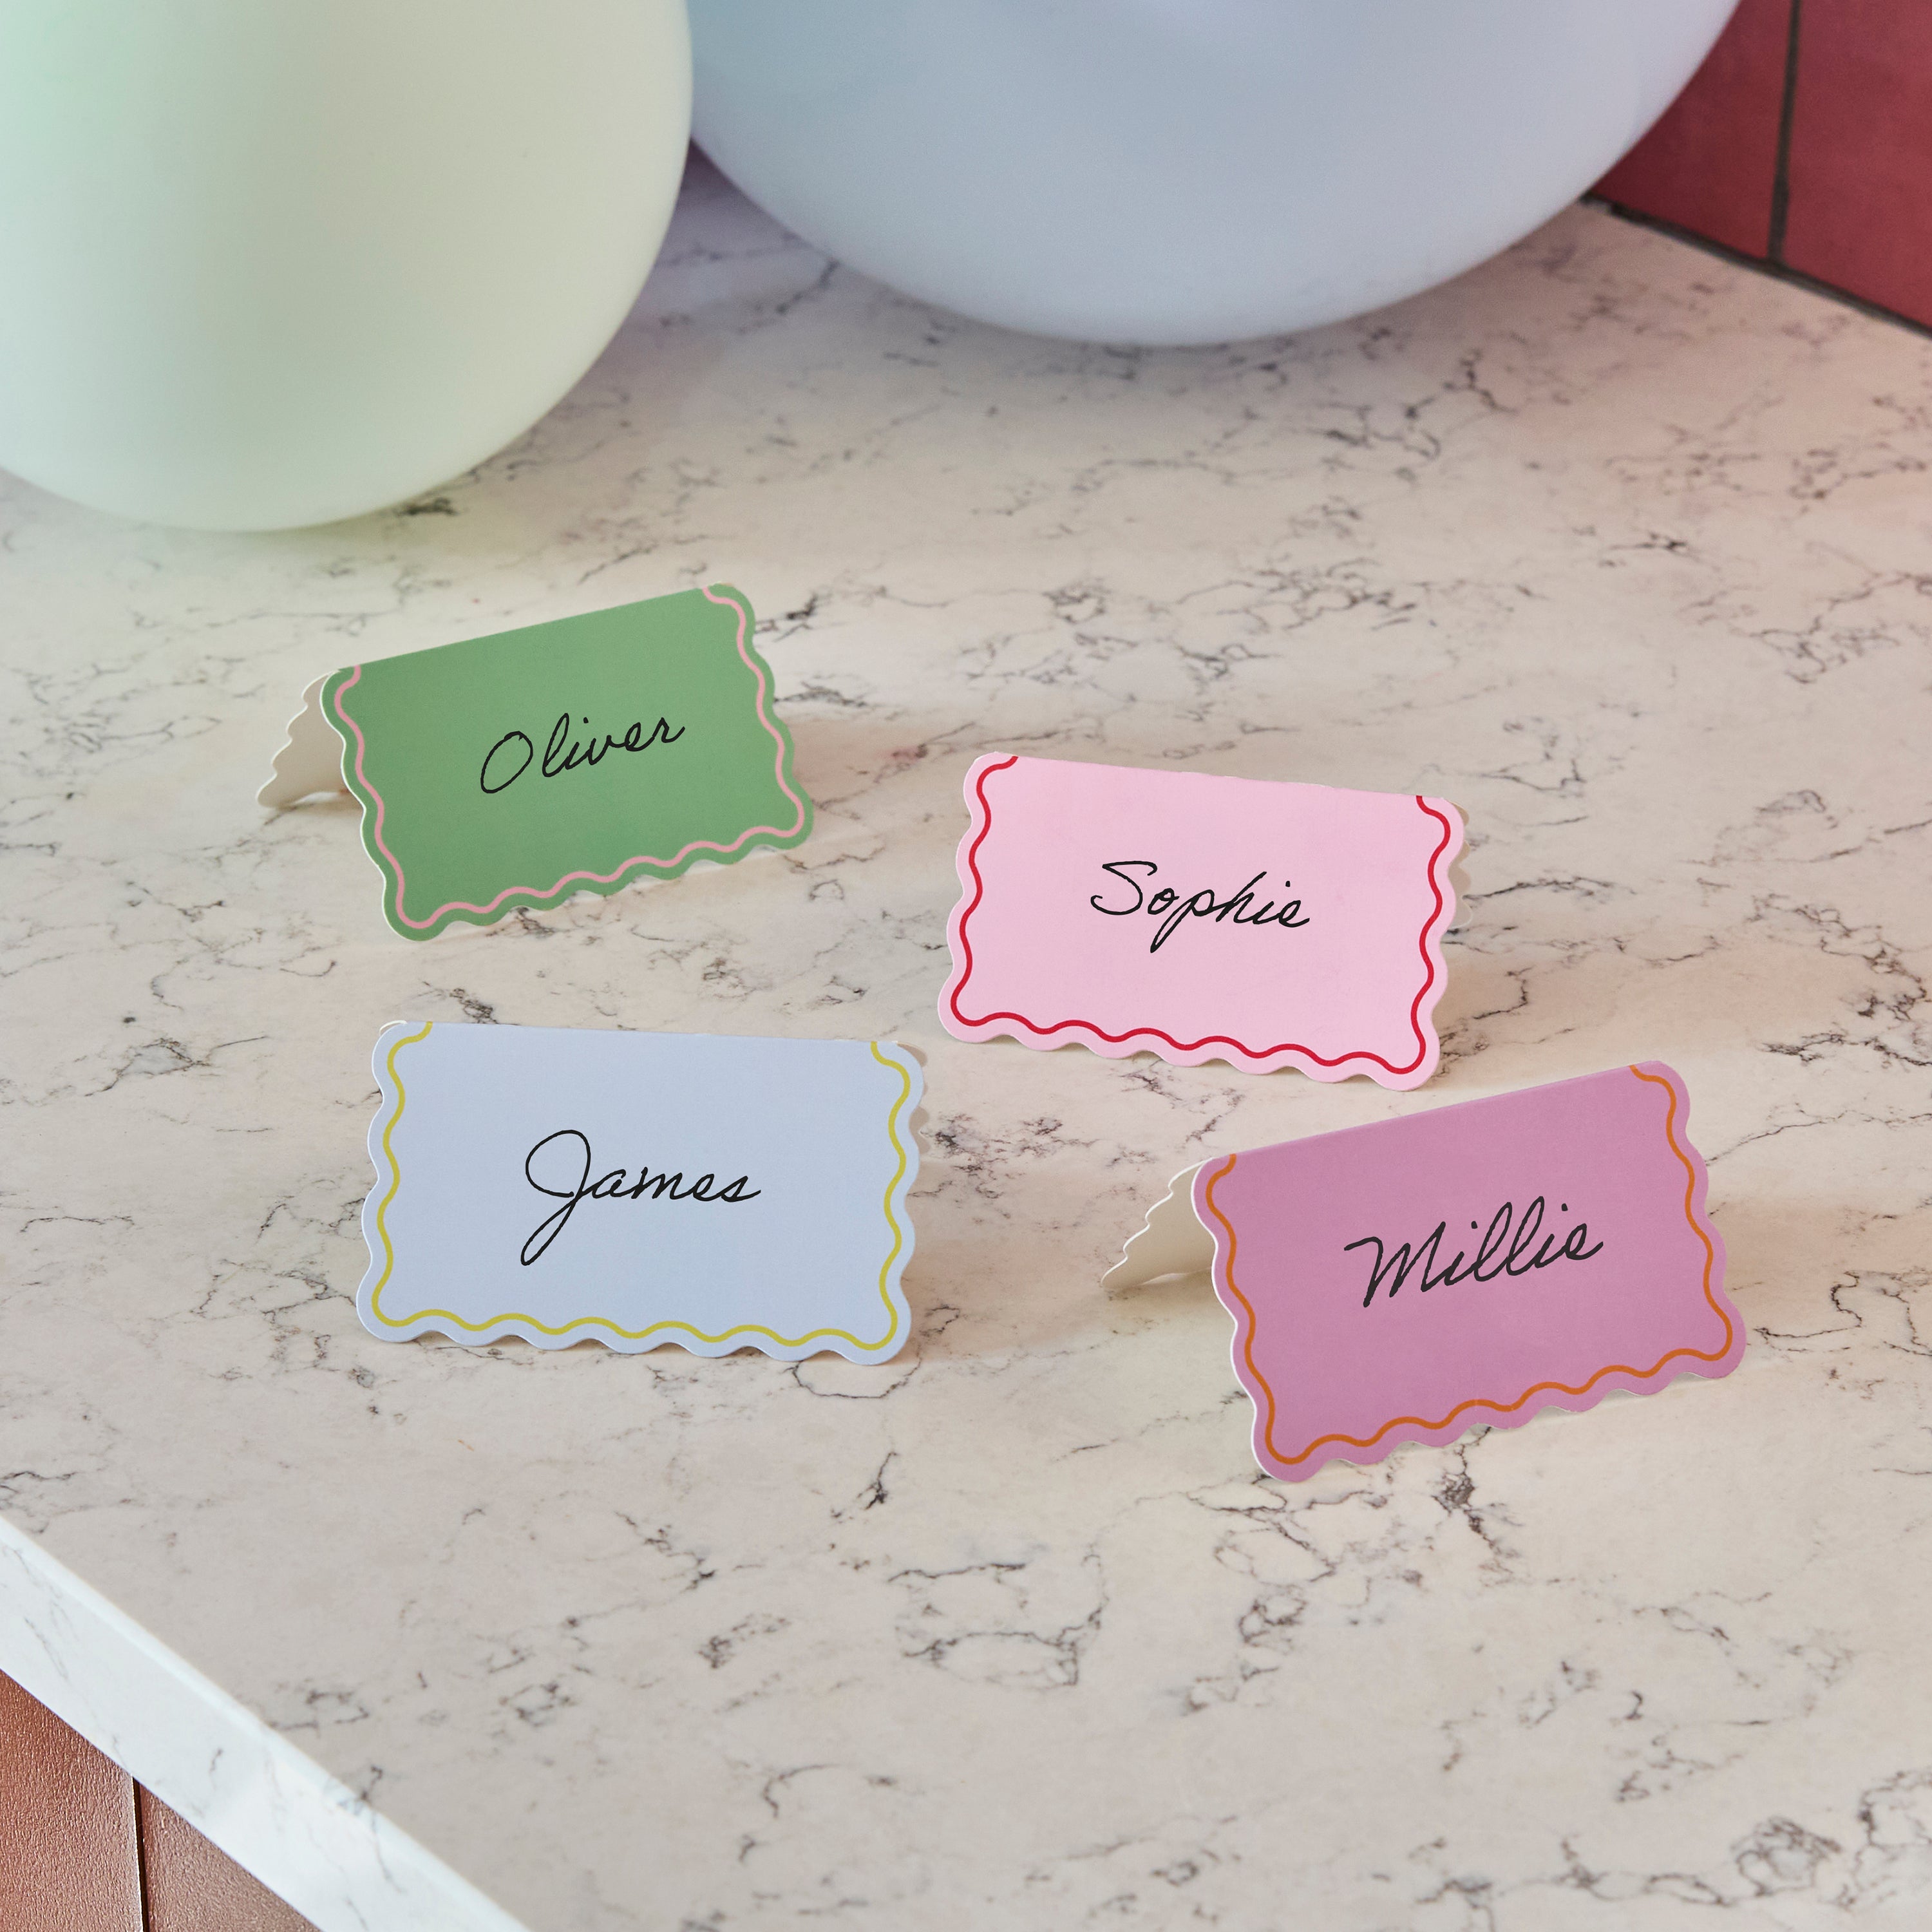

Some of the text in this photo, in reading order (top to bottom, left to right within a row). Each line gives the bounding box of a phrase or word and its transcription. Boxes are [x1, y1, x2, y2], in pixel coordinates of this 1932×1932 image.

[480, 712, 686, 794] Oliver
[1090, 860, 1311, 954] Sophie
[520, 1129, 761, 1267] James
[1343, 1195, 1604, 1308] Millie
